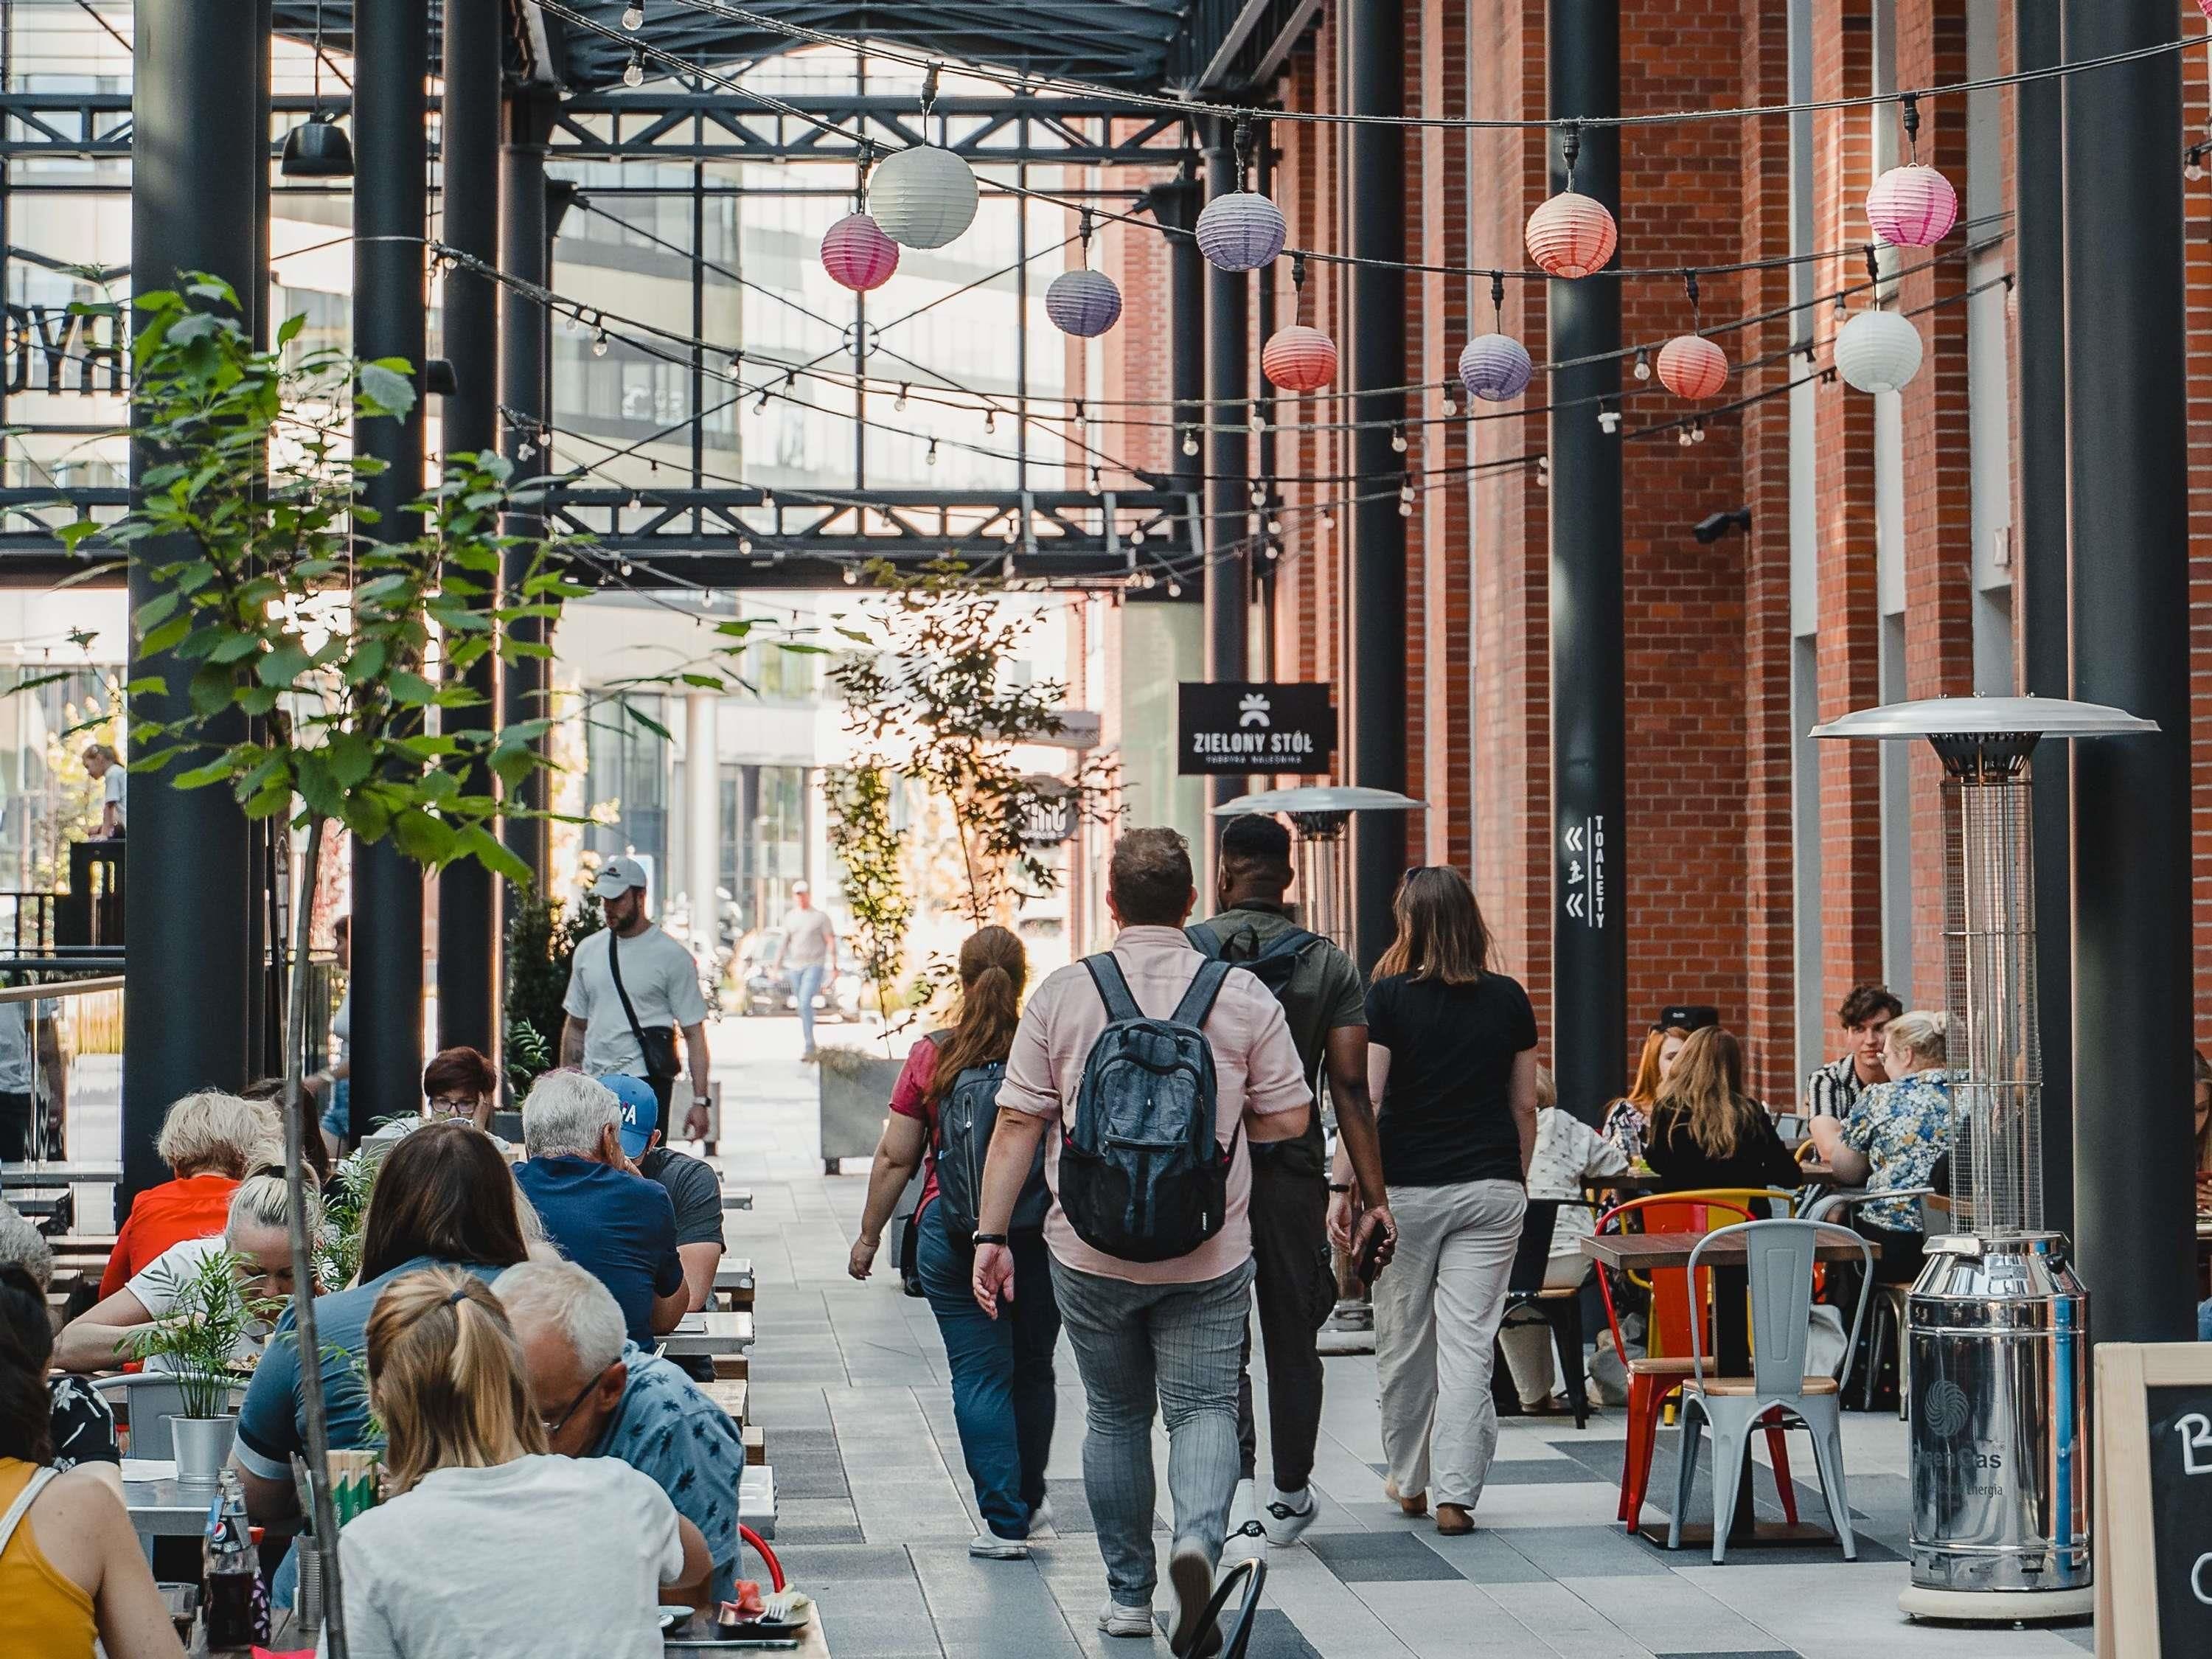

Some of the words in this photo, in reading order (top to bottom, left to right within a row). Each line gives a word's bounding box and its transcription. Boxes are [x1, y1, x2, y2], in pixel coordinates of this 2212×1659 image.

[1194, 733, 1265, 753] ZIELONY
[1271, 730, 1313, 753] STÓŁ
[1595, 815, 1604, 928] TOALETY
